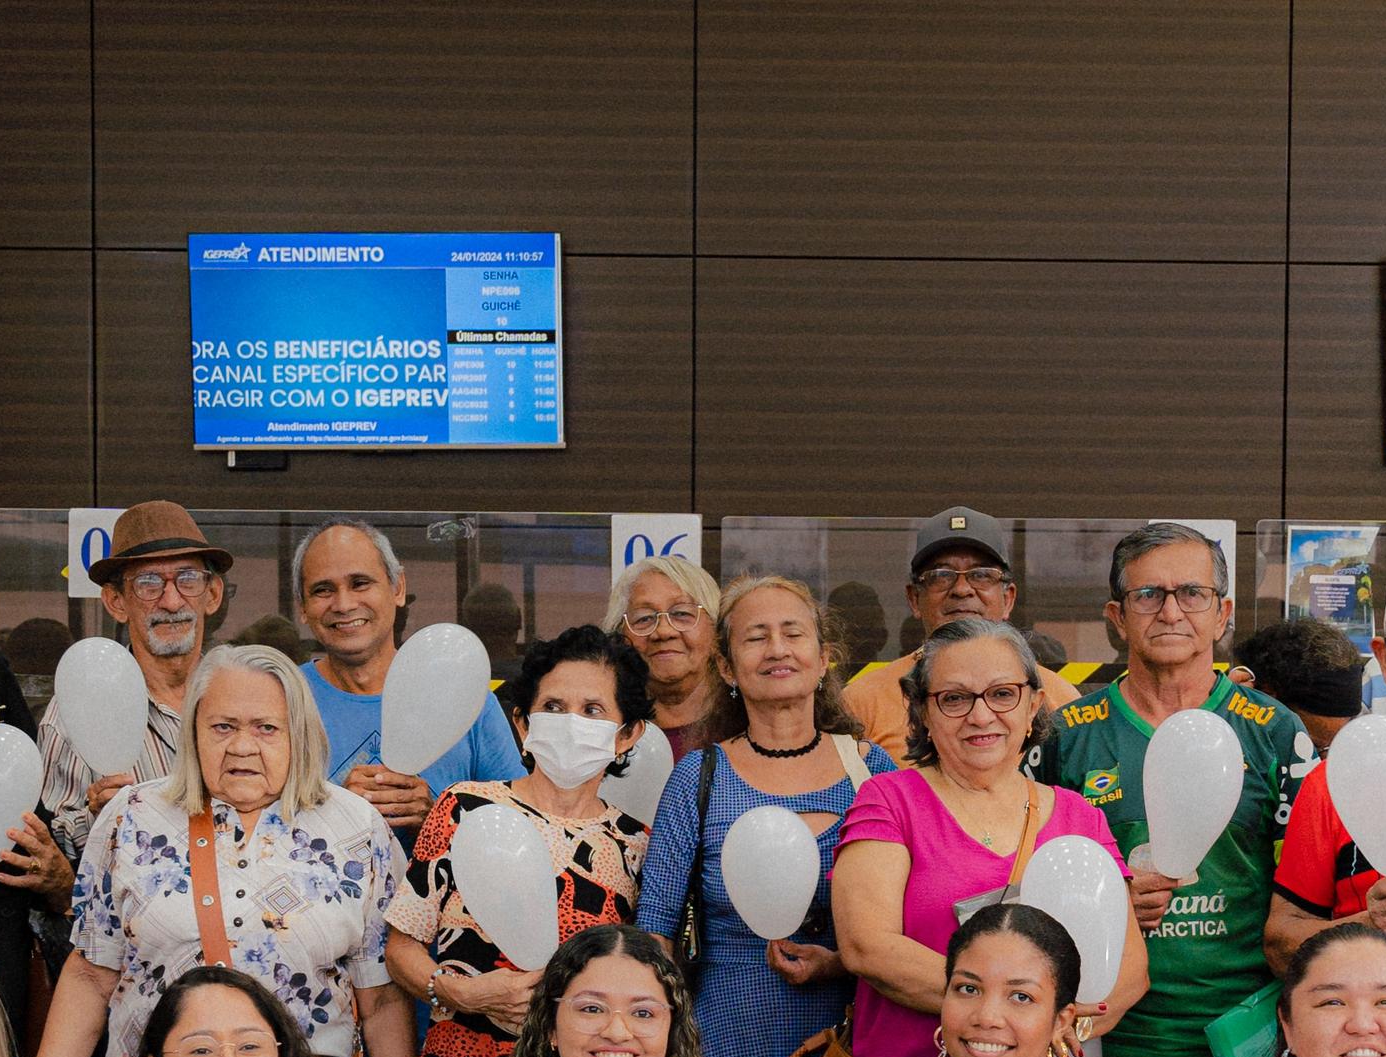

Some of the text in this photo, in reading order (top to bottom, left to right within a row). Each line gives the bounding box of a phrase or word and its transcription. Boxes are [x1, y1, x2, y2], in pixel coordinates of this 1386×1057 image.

[257, 246, 385, 263] ATENDIMENTO
[451, 251, 544, 262] 24/01/2024 11:10:57
[483, 271, 519, 280] SENHA
[481, 299, 522, 311] GUICHÊ
[496, 316, 508, 326] 10
[456, 330, 548, 342] Últimas Chamadas
[237, 341, 268, 359] OS
[274, 335, 441, 359] BENEFICIÁRIOS
[193, 360, 447, 383] CANAL ESPECÍFICO PAR
[193, 389, 449, 408] RAGIR COM O IGEPREV
[267, 421, 377, 432] Atendimento IGEPREV
[81, 527, 112, 573] 0
[1063, 697, 1110, 728] Itaú
[1227, 692, 1276, 725] Itaú
[1143, 919, 1229, 938] ARCTICA
